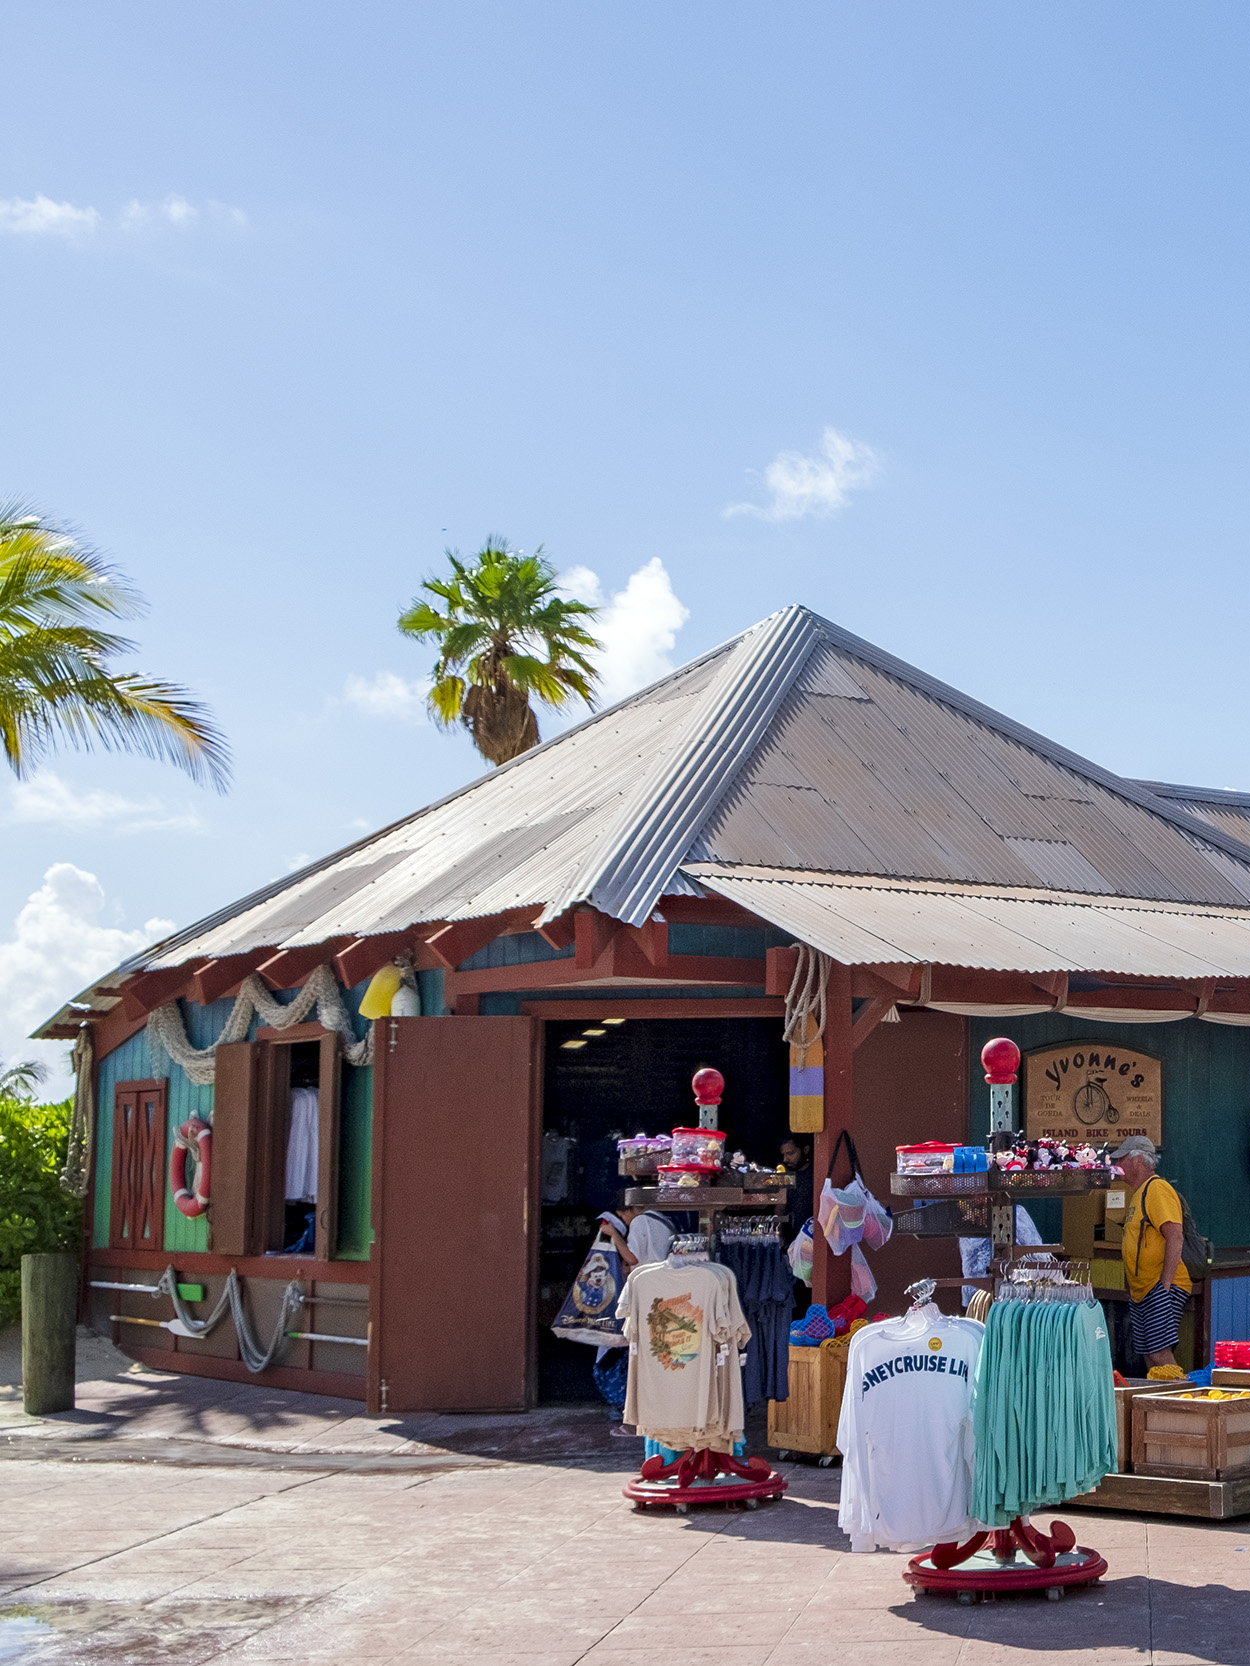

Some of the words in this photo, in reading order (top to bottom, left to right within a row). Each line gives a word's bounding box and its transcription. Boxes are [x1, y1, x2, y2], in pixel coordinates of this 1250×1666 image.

[1045, 1052, 1144, 1091] Yvonne's
[1042, 1128, 1078, 1138] ISLAND
[1086, 1128, 1108, 1138] BIKE
[1116, 1128, 1147, 1138] TOURS
